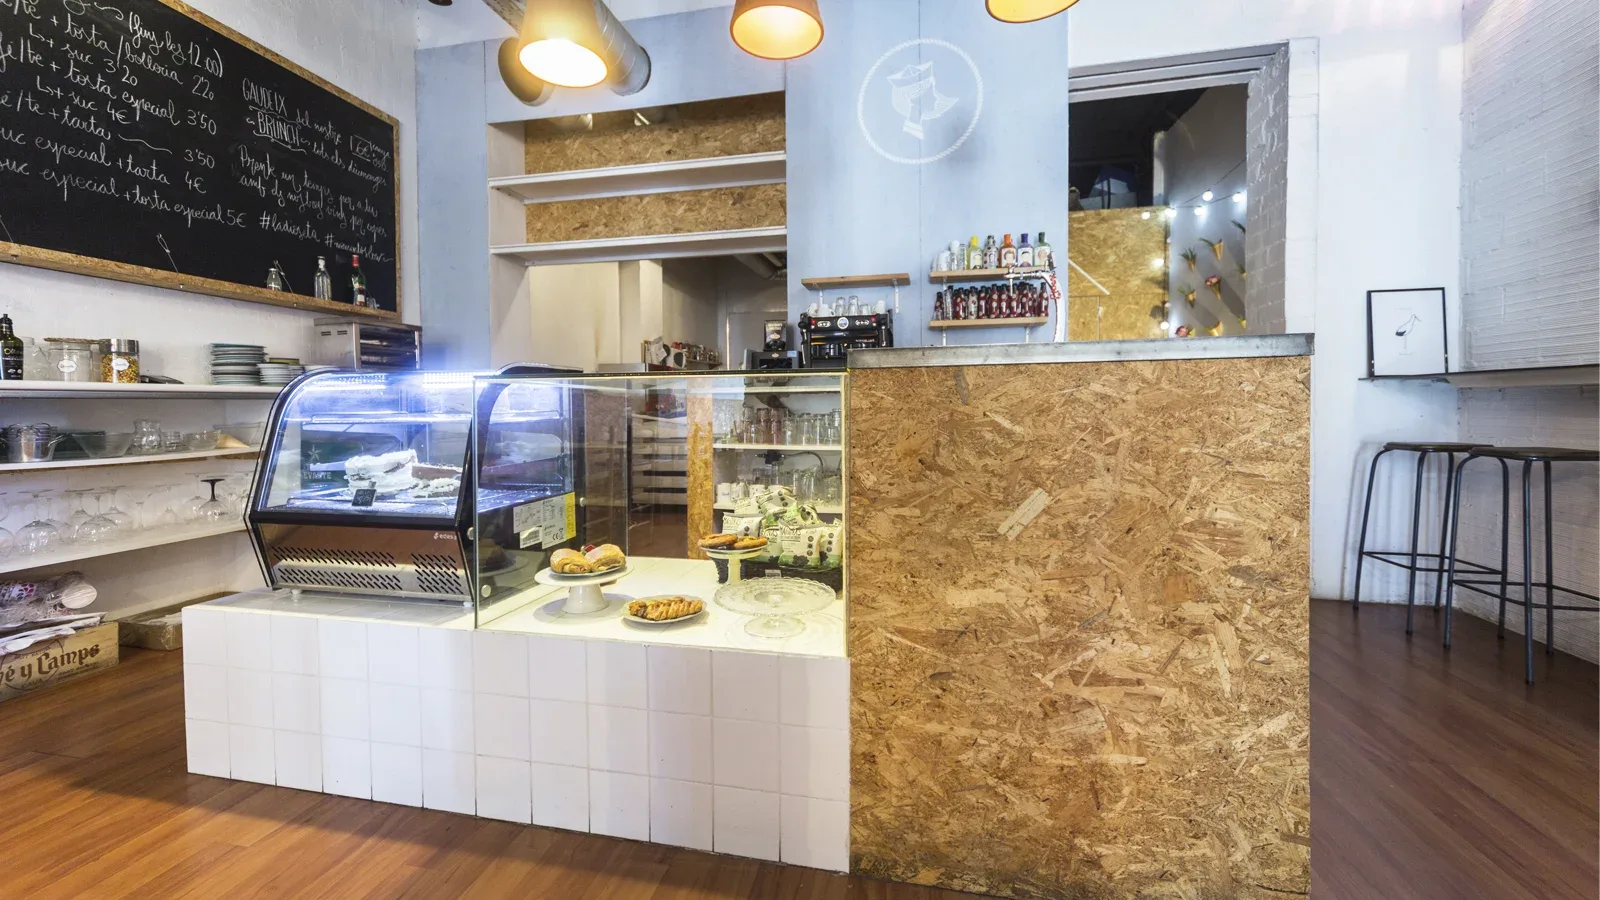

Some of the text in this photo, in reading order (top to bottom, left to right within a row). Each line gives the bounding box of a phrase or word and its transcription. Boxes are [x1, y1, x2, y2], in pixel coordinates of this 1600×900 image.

[61, 44, 94, 65] suc
[64, 60, 117, 99] tosta
[122, 91, 180, 126] especial
[68, 92, 97, 111] suc
[107, 101, 131, 124] 4€
[242, 78, 288, 118] GAUDEIX
[61, 105, 111, 140] tarta
[258, 111, 300, 147] BRUNCH
[35, 137, 111, 167] especial
[185, 171, 206, 193] 4€
[39, 169, 120, 202] especial
[174, 204, 225, 228] especial
[226, 209, 247, 228] 5€
[20, 663, 32, 683] y
[37, 644, 100, 675] Camps
